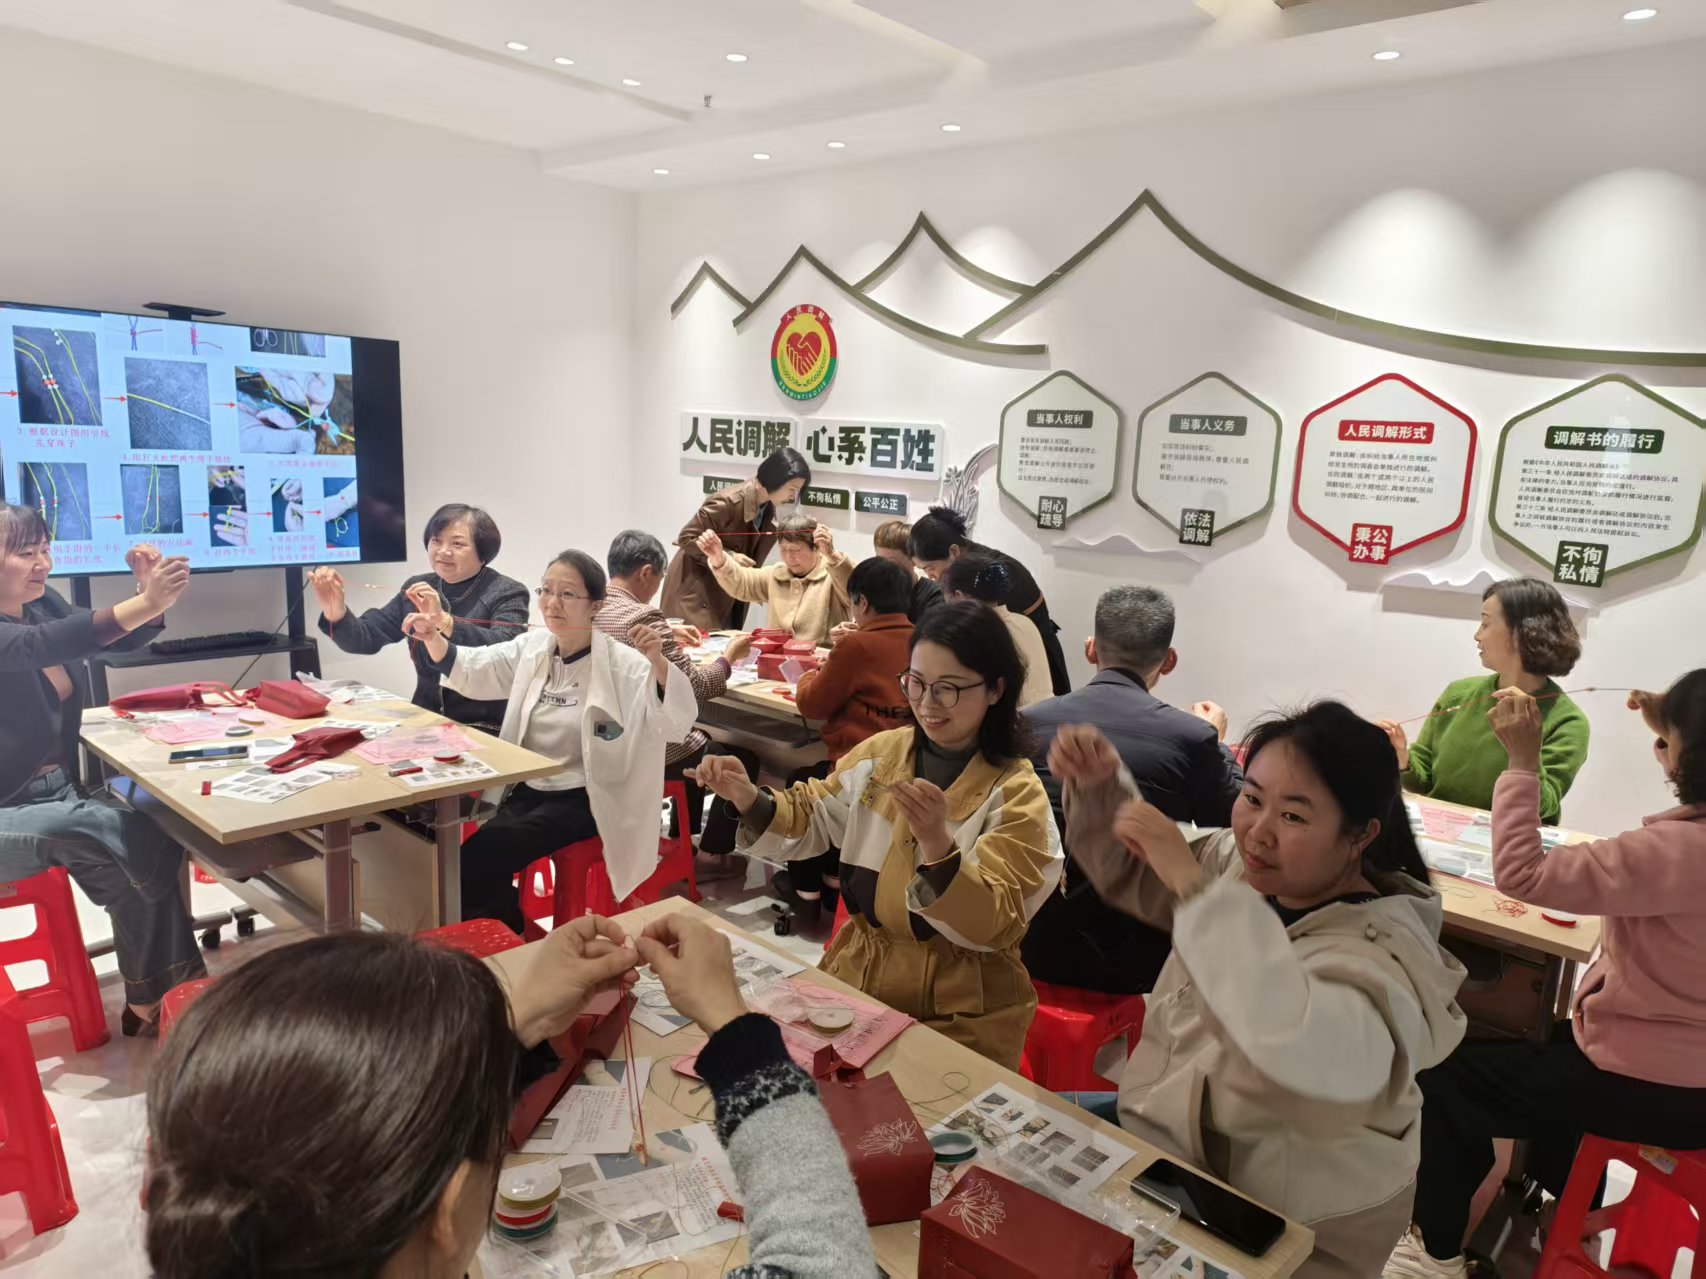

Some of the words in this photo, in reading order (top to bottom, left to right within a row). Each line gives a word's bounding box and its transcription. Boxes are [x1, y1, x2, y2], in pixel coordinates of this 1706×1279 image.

[1035, 412, 1084, 426] 当事人权利
[1179, 417, 1236, 432] 当事人义务
[682, 416, 791, 459] 人民调解
[1344, 423, 1428, 441] 人民调解形式
[1553, 430, 1656, 450] 调解书的履行
[806, 424, 936, 473] 心系百姓
[863, 496, 899, 511] 公平公正
[1041, 498, 1065, 514] 耐心
[1039, 512, 1064, 528] 疏导
[1183, 511, 1212, 528] 依法
[1182, 526, 1211, 543] 调解
[1355, 527, 1388, 545] 秉公
[1353, 543, 1386, 561] 办事
[1562, 545, 1603, 565] 不徇
[1558, 563, 1600, 584] 私情
